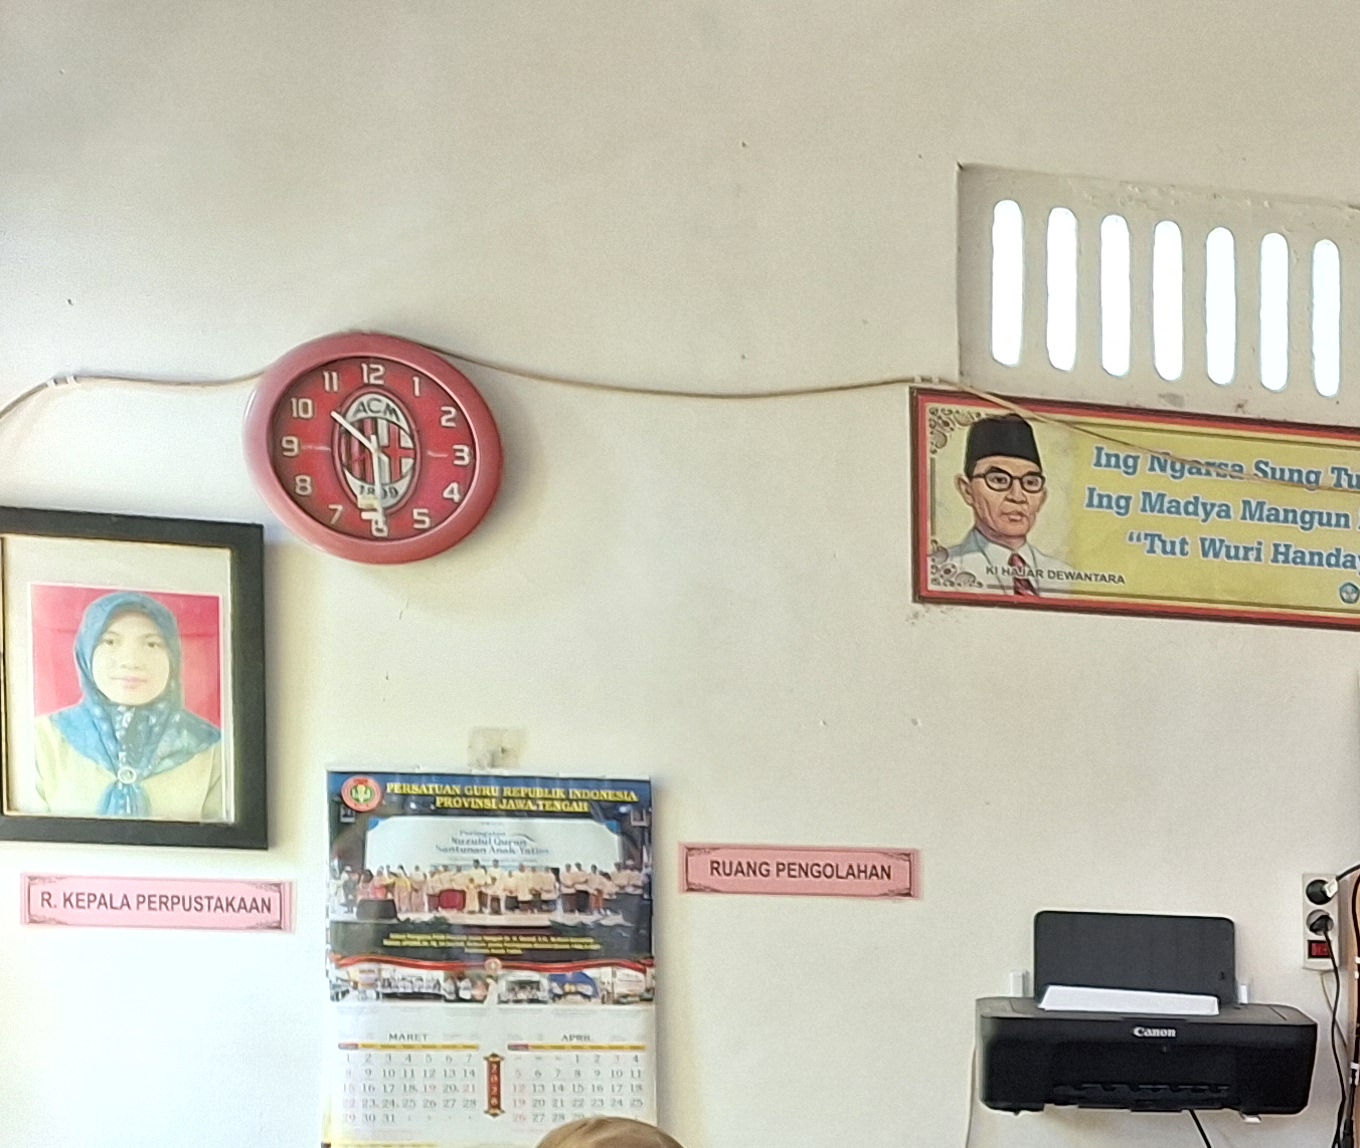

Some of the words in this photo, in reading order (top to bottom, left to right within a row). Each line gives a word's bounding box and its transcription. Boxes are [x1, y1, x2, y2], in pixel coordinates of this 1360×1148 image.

[323, 371, 338, 392] 11
[361, 363, 385, 385] 12
[291, 398, 313, 418] 10
[352, 399, 399, 420] ACM
[1093, 445, 1141, 476] Ing
[1254, 460, 1321, 493] Sung
[1085, 487, 1132, 516] Ing
[1140, 491, 1232, 526] Madya
[1239, 500, 1351, 533] Mangun
[1198, 536, 1263, 564] Wuri
[985, 565, 998, 577] KI
[1001, 565, 1043, 579] HAJAR
[1047, 569, 1126, 585] DEWANTARA
[386, 783, 461, 796] PERSATUAN
[464, 784, 498, 798] GURU
[503, 787, 566, 799] REPUBLIK
[569, 788, 639, 802] INDONESIA
[436, 797, 497, 809] PROVINSI
[500, 799, 532, 810] JAWA
[540, 800, 589, 812] TENGAH
[710, 860, 770, 877] RUANG
[776, 863, 891, 880] PENGOLAHAN
[40, 891, 58, 908] R.
[62, 892, 131, 910] KEPALA
[136, 894, 272, 914] PERPUSTAKAAN
[1133, 1026, 1176, 1038] Canon
